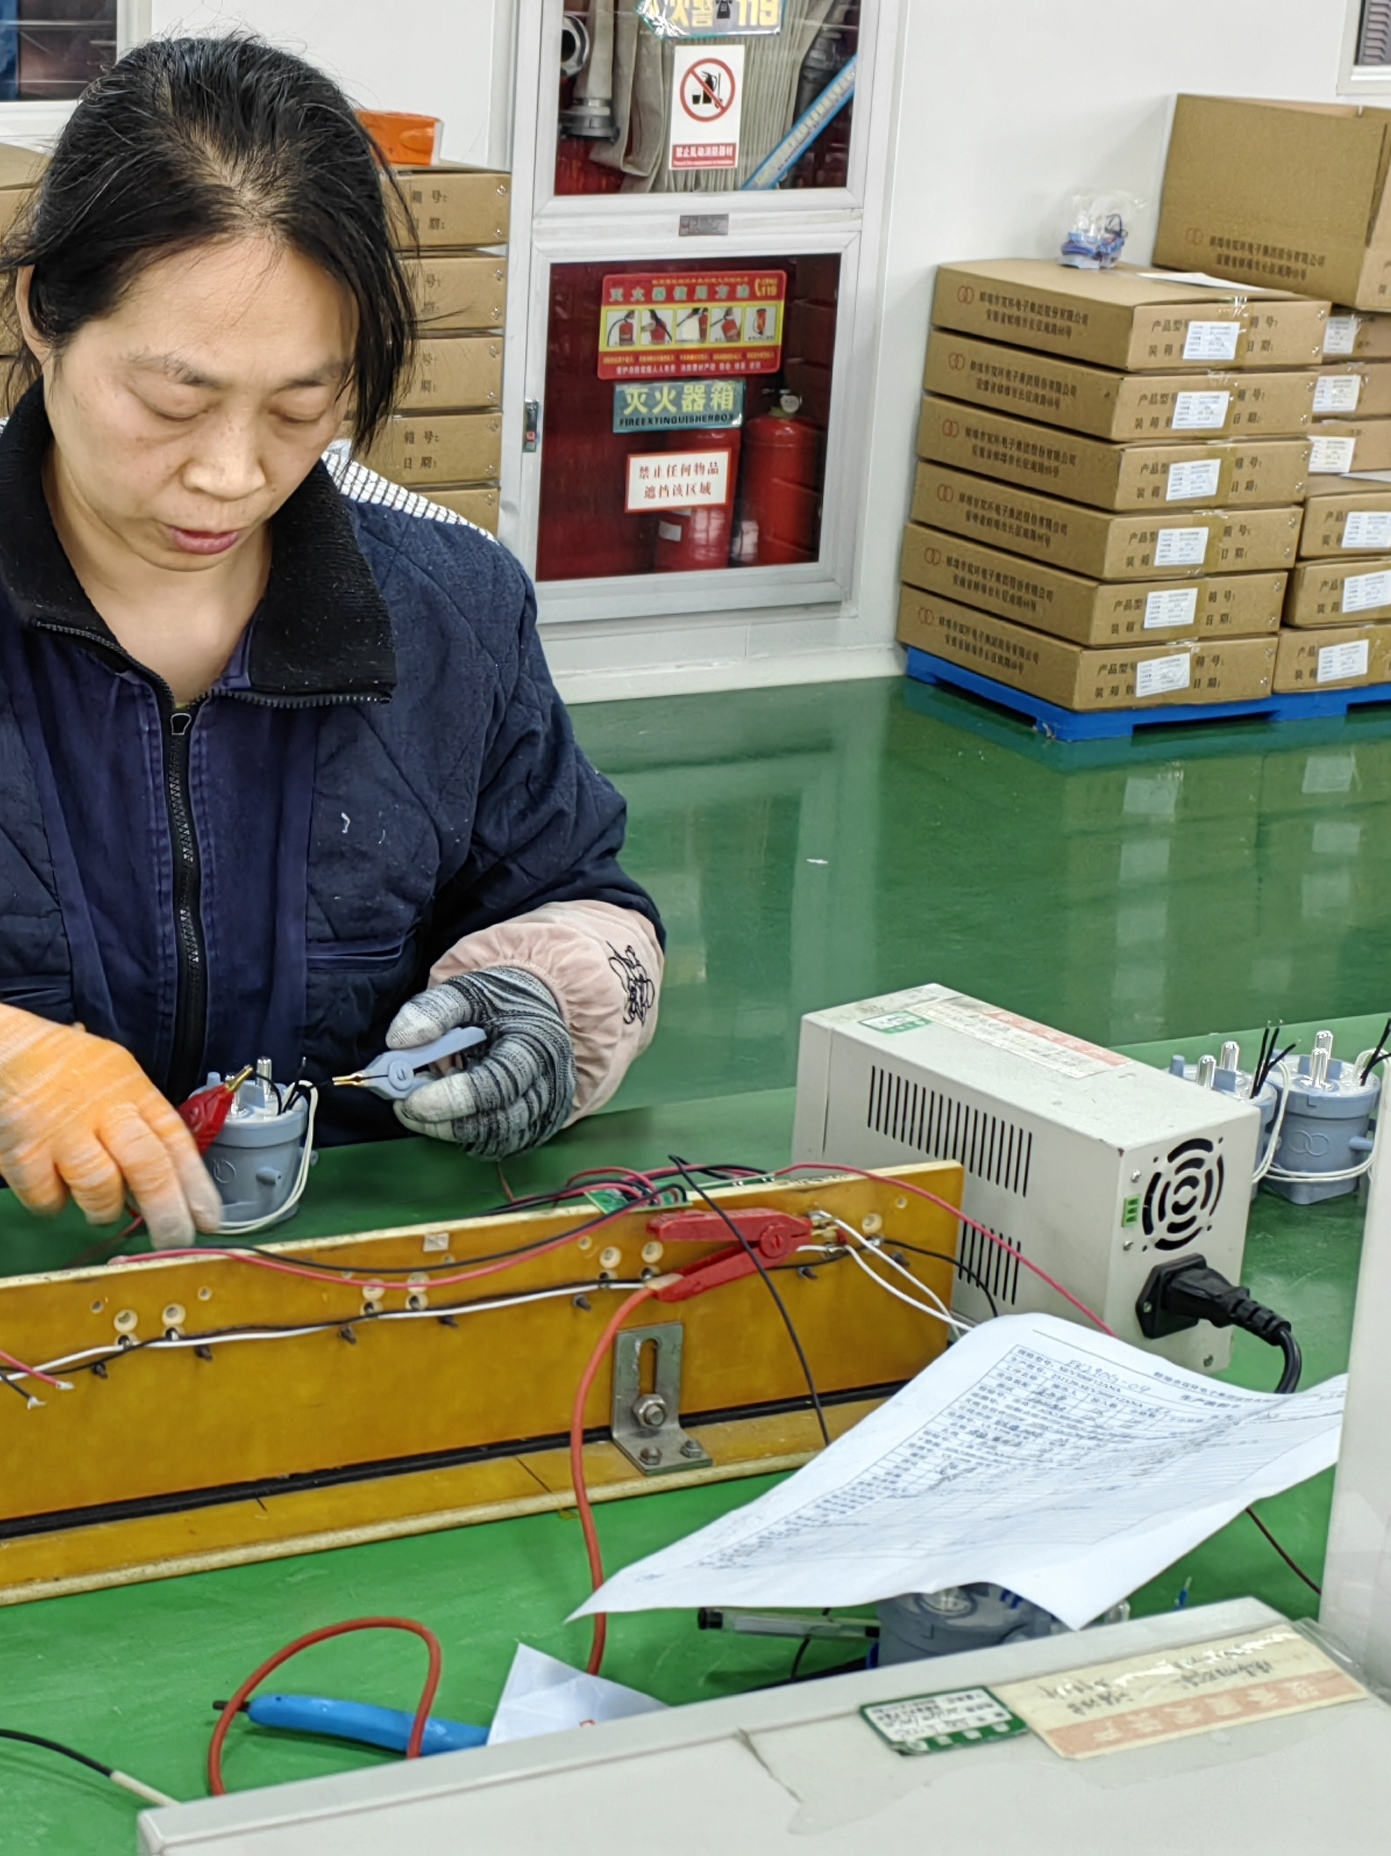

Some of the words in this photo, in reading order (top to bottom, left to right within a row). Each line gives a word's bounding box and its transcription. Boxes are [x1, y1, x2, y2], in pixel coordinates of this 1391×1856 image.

[738, 0, 779, 26] 119
[609, 284, 751, 302] 灭火器使用方法
[623, 381, 734, 415] 灭火器箱
[639, 461, 719, 480] 禁止任何物品
[644, 481, 711, 499] 遮挡该区域
